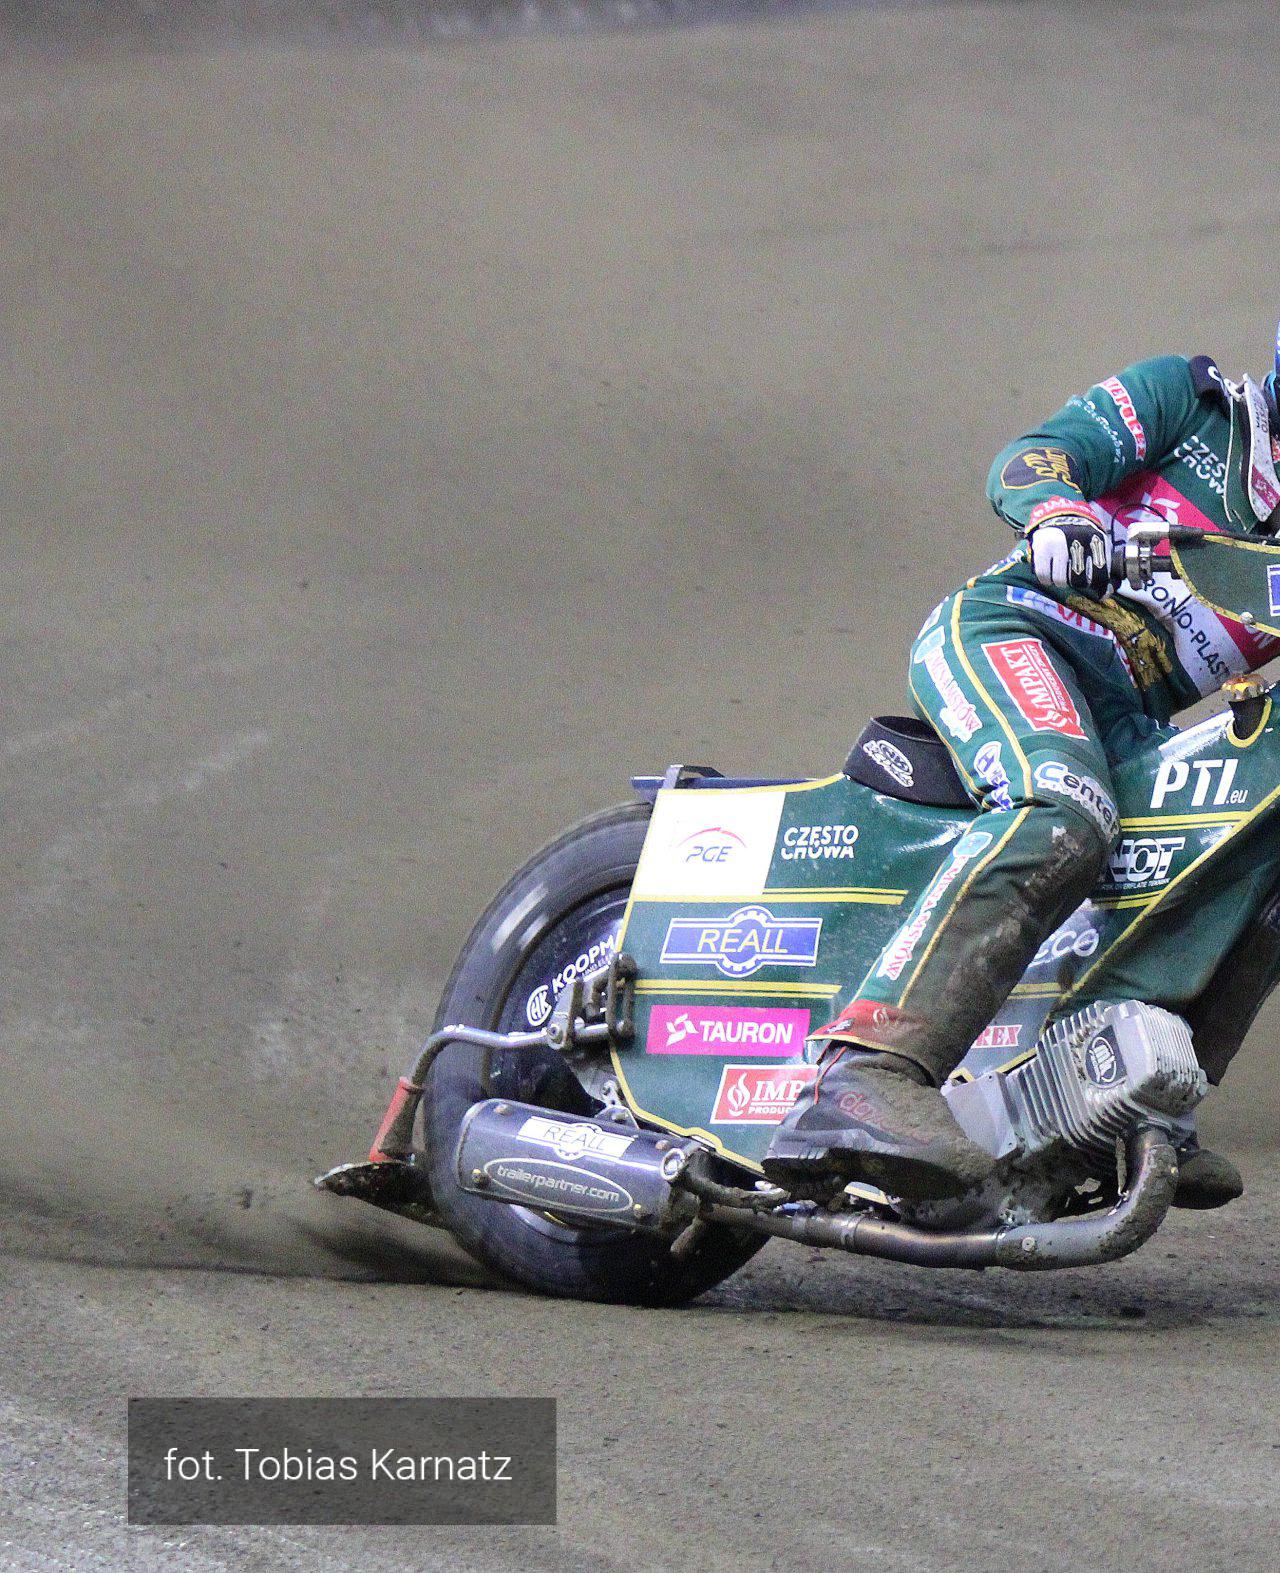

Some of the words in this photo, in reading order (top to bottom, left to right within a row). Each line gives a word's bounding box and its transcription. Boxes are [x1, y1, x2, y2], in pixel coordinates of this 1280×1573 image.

[1000, 646, 1057, 712] IMPAKT
[686, 845, 733, 863] PGE
[697, 928, 788, 953] REALL
[552, 934, 615, 993] KOOPM
[700, 1020, 793, 1044] TAURON
[976, 1026, 1020, 1046] REX
[753, 1080, 805, 1100] IMP
[748, 1106, 793, 1114] PRODUC
[543, 1126, 606, 1150] REALL
[497, 1165, 620, 1201] trailerpartner.com
